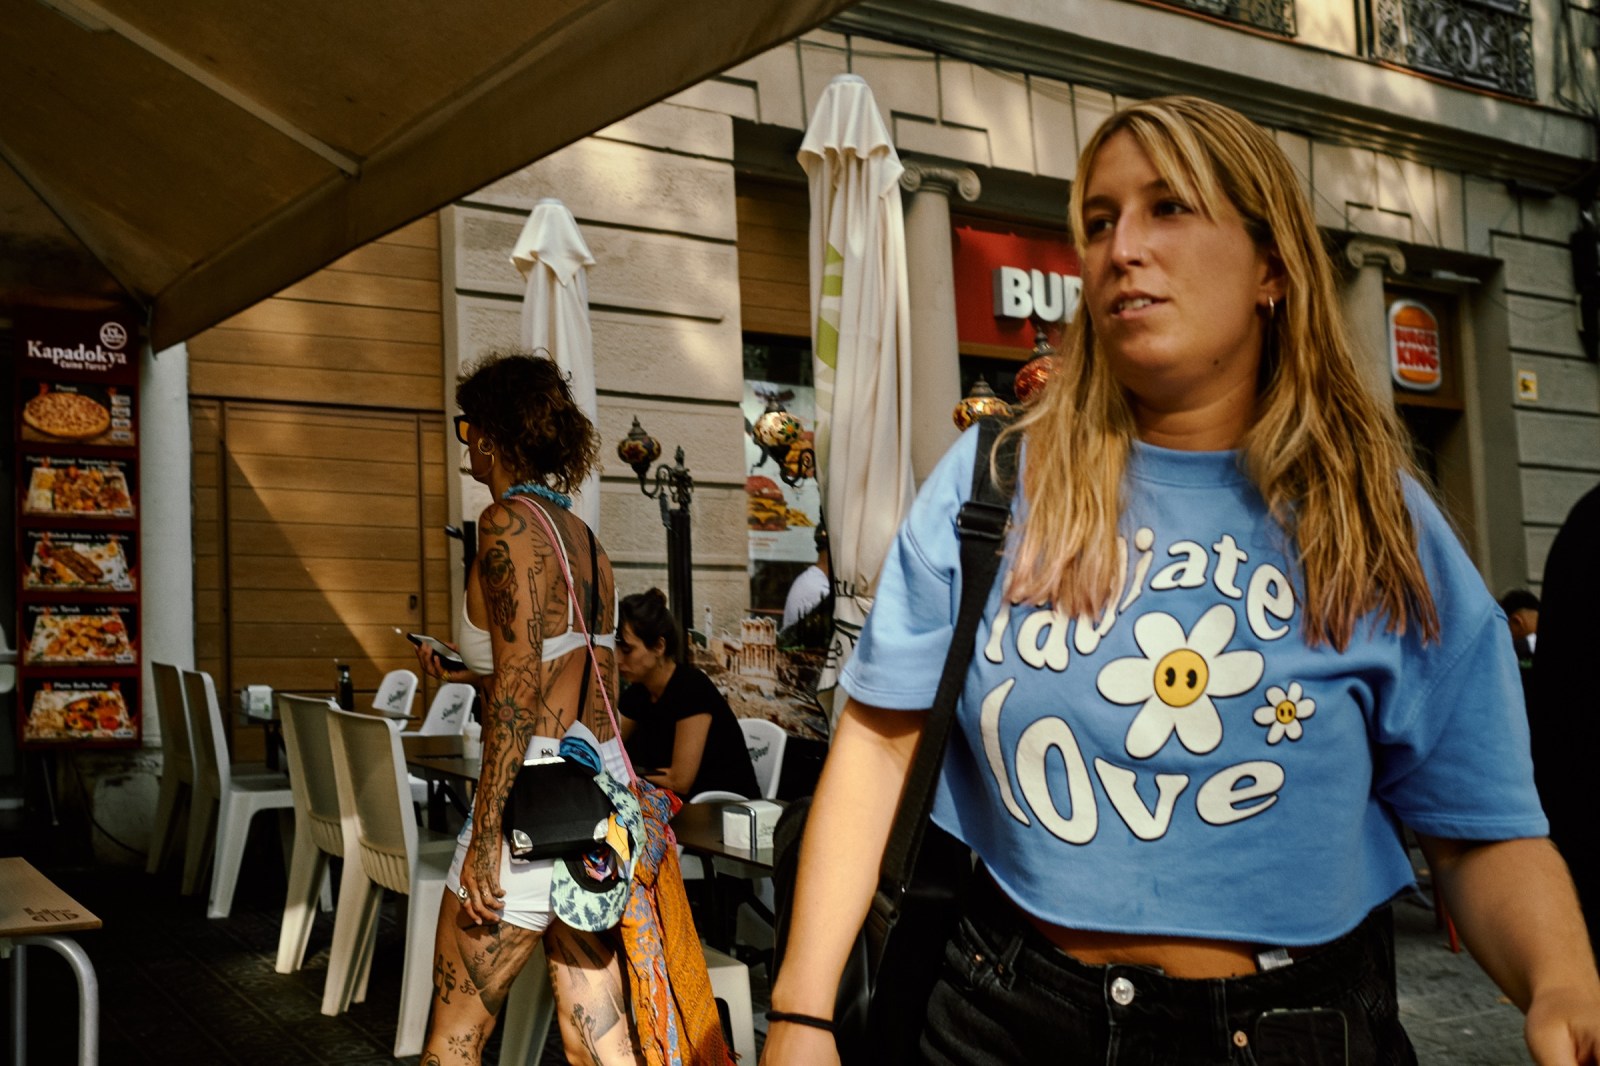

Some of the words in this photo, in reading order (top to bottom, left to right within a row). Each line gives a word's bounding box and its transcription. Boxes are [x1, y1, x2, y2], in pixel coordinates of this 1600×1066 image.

[27, 340, 127, 367] Kapadokya
[1396, 345, 1439, 371] KING
[980, 677, 1286, 846] love
